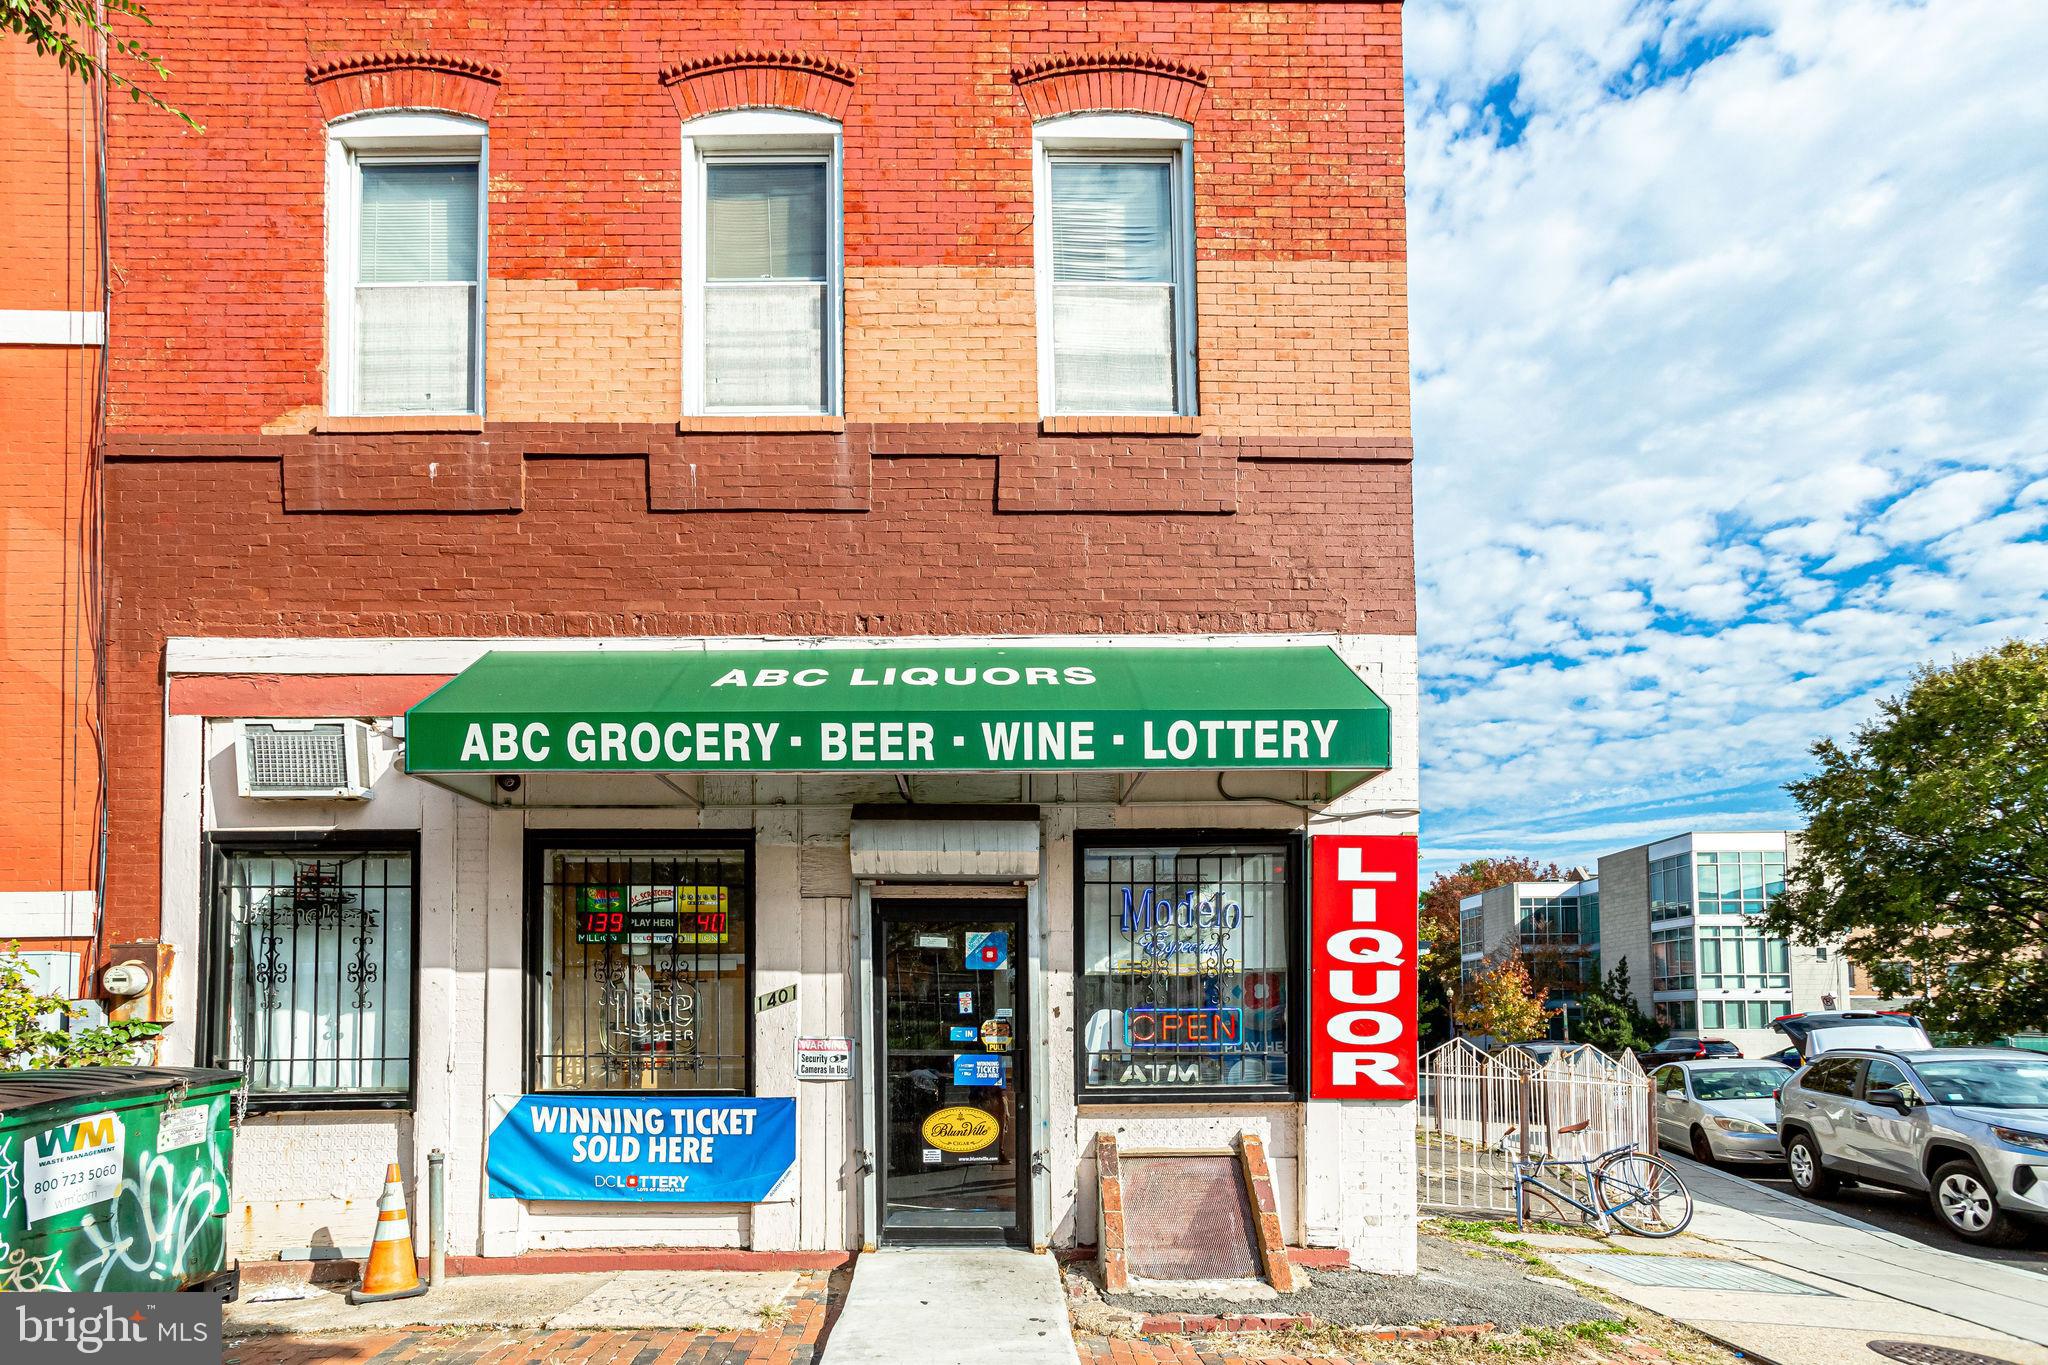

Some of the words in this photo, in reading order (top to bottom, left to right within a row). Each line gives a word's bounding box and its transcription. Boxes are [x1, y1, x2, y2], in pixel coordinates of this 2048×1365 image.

[711, 669, 829, 687] ABC
[849, 667, 1097, 686] LIQUORS
[460, 722, 550, 762] ABC
[566, 722, 780, 762] GROCERY
[820, 722, 935, 762] BEER
[981, 722, 1095, 761] WINE
[1143, 720, 1339, 760] LOTTERY
[1121, 887, 1242, 932] Modelo
[587, 913, 624, 933] 139
[698, 913, 726, 933] 40
[1326, 847, 1406, 1086] LIQUOR
[758, 984, 797, 1012] 1401
[653, 1030, 694, 1041] BEER
[1132, 1014, 1236, 1041] OPEN
[799, 1040, 848, 1051] WARNING
[1224, 1042, 1260, 1053] PLAY
[1266, 1041, 1284, 1052] HE
[801, 1053, 828, 1064] Security
[800, 1064, 828, 1074] Cameras
[829, 1065, 835, 1074] In
[836, 1065, 848, 1074] Use
[1119, 1064, 1200, 1083] ATM
[530, 1106, 665, 1135] WINNING
[671, 1108, 757, 1135] TICKET
[931, 1121, 988, 1137] BluntVille
[35, 1117, 115, 1159] WM
[39, 1158, 64, 1168] WASTE
[66, 1146, 116, 1161] MANAGEMENT
[572, 1136, 641, 1163] SOLD
[647, 1137, 714, 1164] HERE
[34, 1178, 58, 1194] 800
[62, 1171, 84, 1187] 723
[88, 1164, 117, 1181] 5060
[54, 1190, 98, 1209] wm.com
